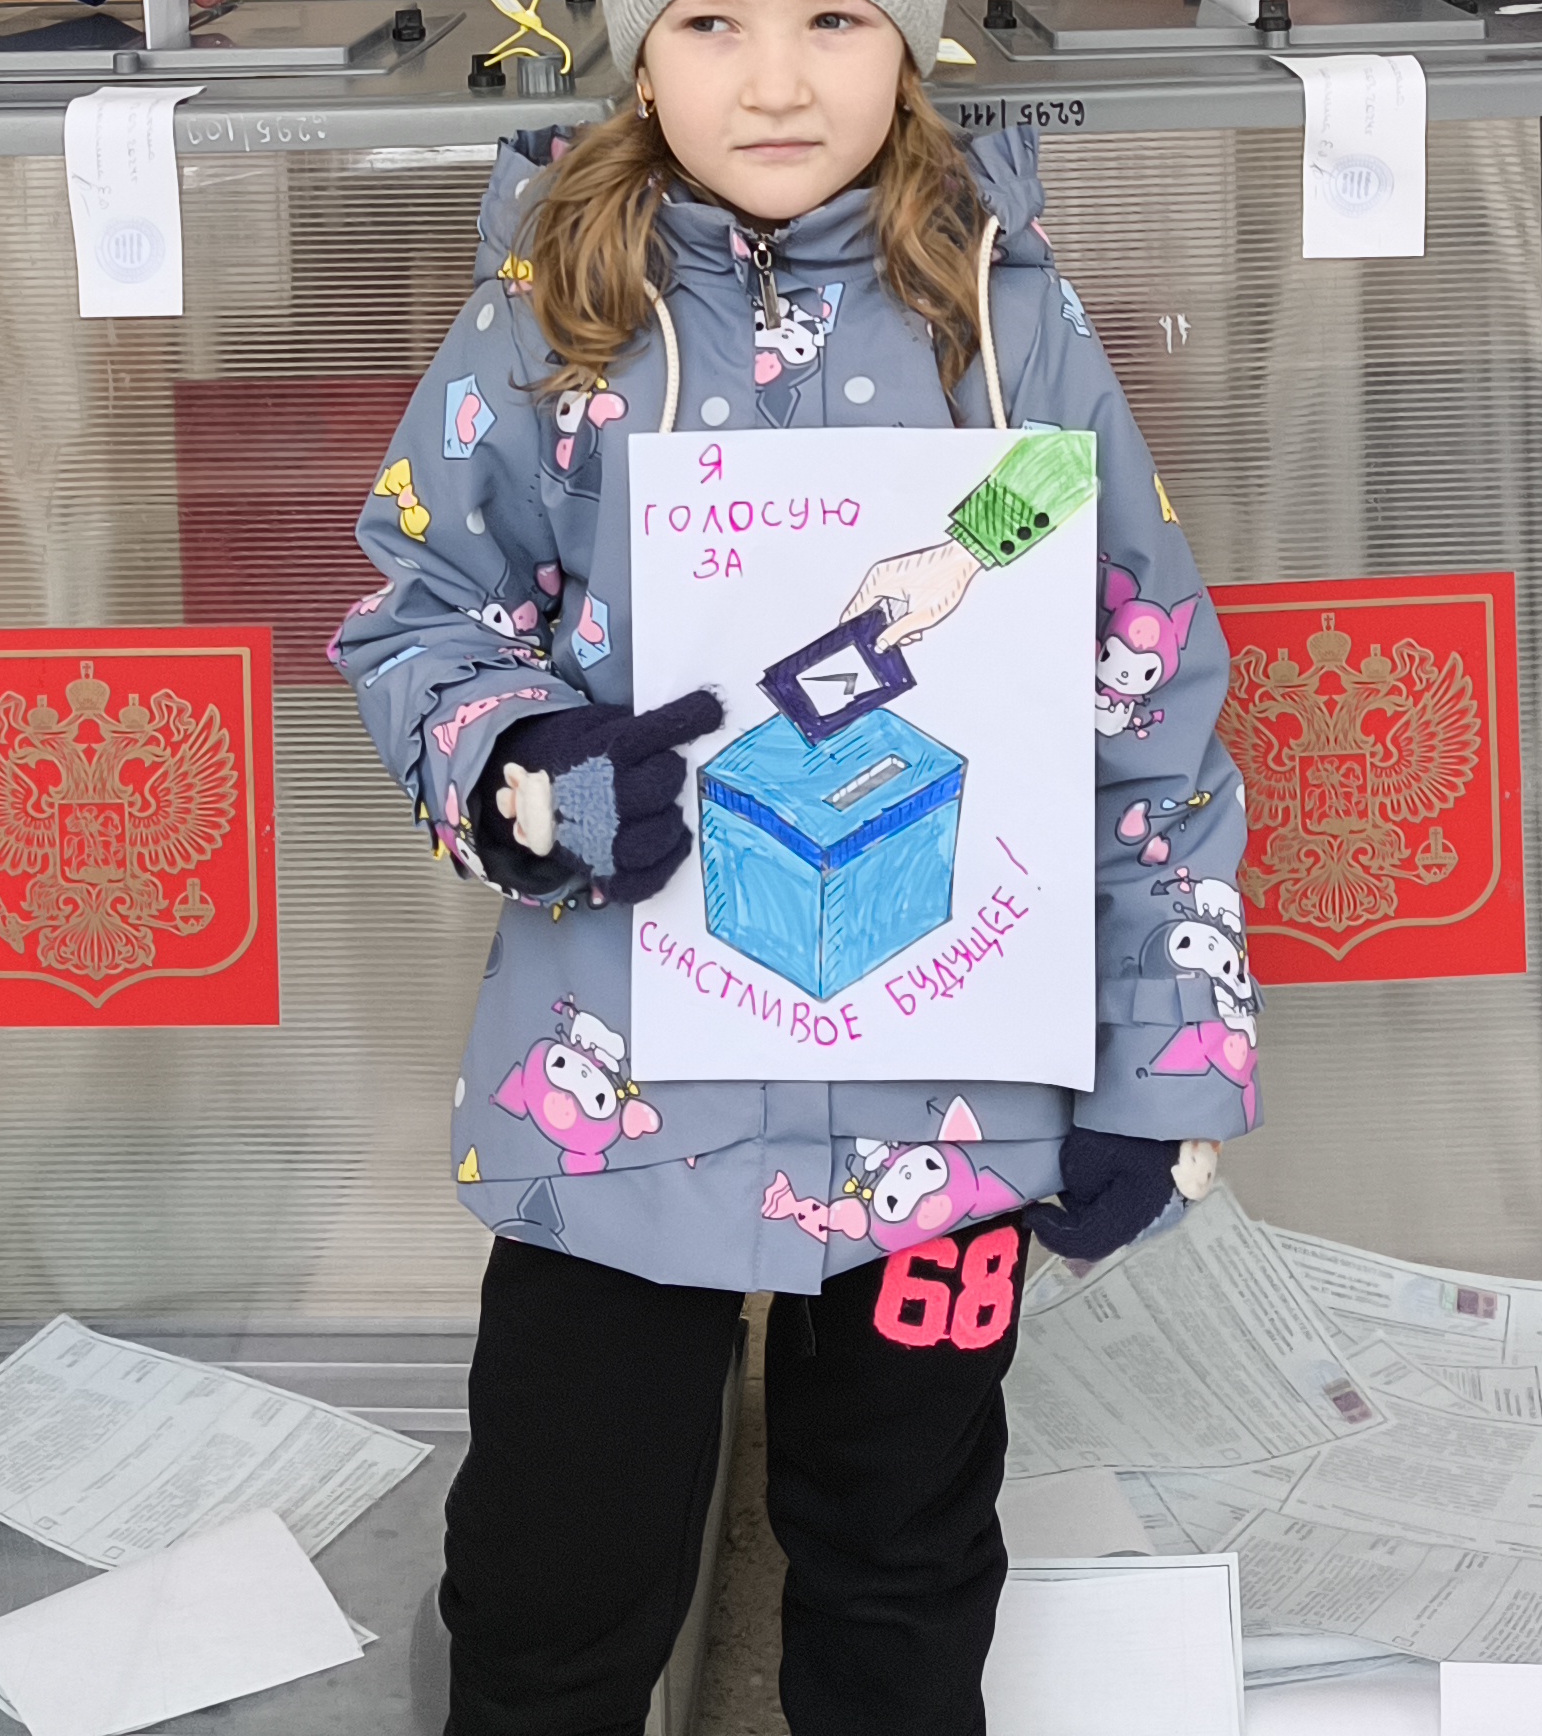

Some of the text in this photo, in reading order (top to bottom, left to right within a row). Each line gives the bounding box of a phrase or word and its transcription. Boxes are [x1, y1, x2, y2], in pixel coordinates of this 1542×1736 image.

[698, 443, 723, 483] Я
[644, 497, 860, 535] ГОЛОСУЮ
[693, 548, 743, 579] ЗА
[640, 920, 862, 1046] СЧАСТЛИВОЕ
[873, 1225, 1019, 1350] 68
